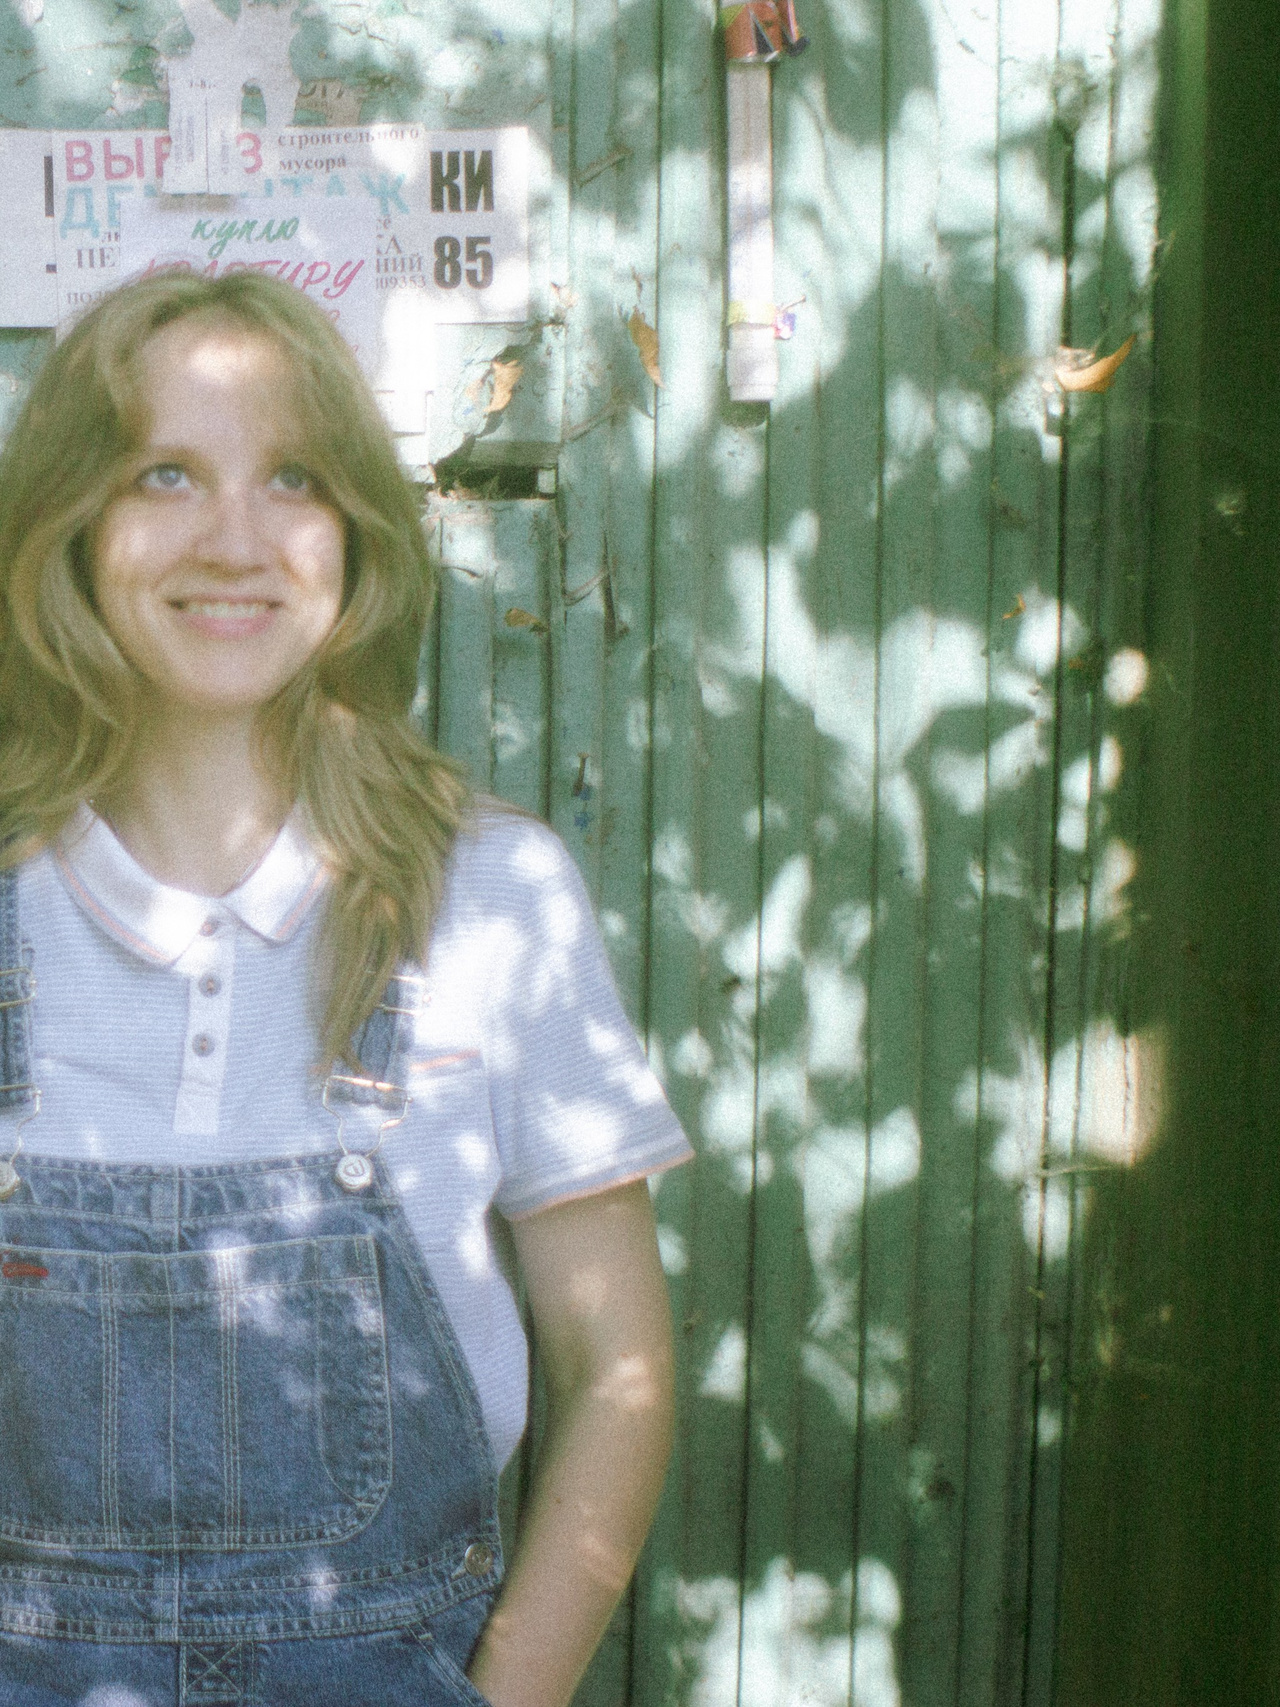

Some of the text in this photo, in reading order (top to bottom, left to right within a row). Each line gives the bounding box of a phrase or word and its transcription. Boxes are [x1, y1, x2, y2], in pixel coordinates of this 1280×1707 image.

[64, 132, 264, 182] ВЫЗ
[278, 153, 348, 174] мусора
[432, 234, 495, 291] 85
